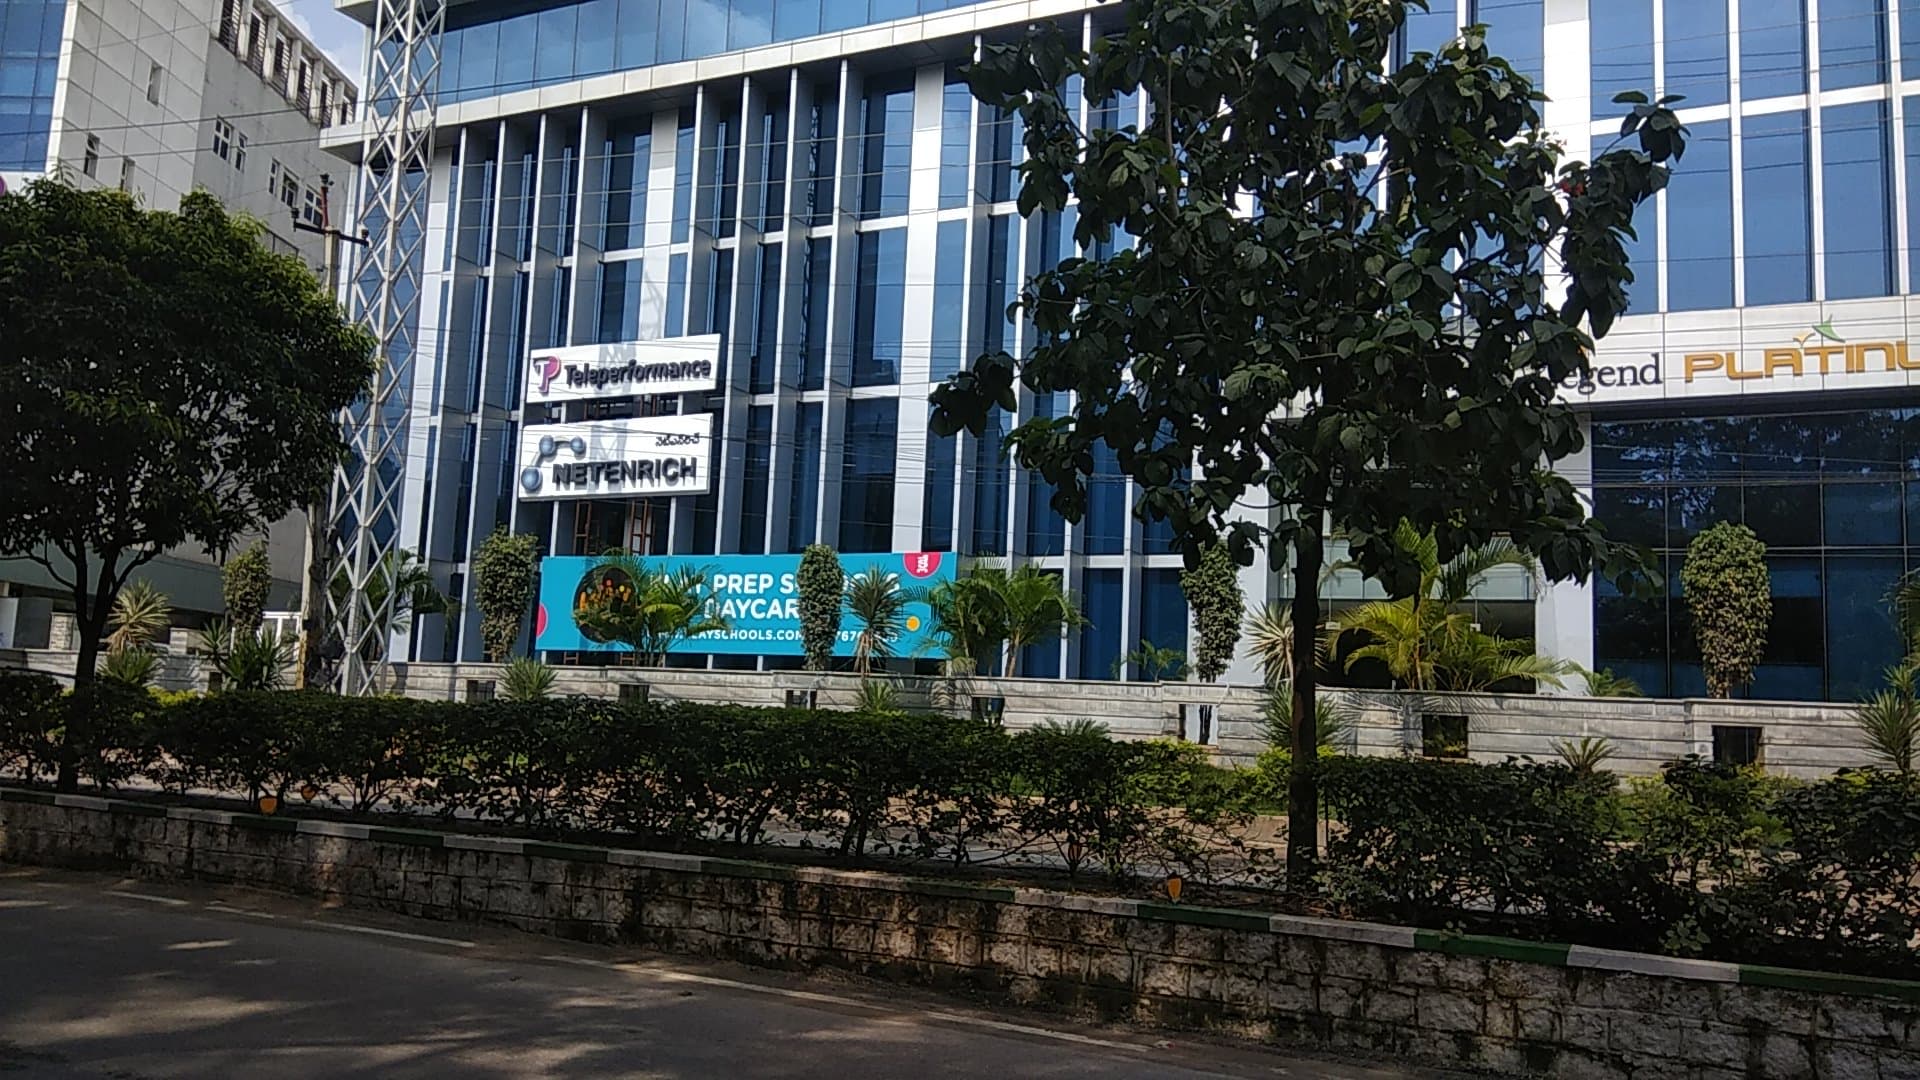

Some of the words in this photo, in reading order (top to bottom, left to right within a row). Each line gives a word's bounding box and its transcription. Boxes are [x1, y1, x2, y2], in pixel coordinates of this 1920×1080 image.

[564, 359, 711, 389] Teleperformance
[1555, 352, 1663, 395] egend
[552, 457, 698, 486] NETENRICH
[713, 574, 774, 594] PREP
[704, 598, 800, 619] DAYCAR
